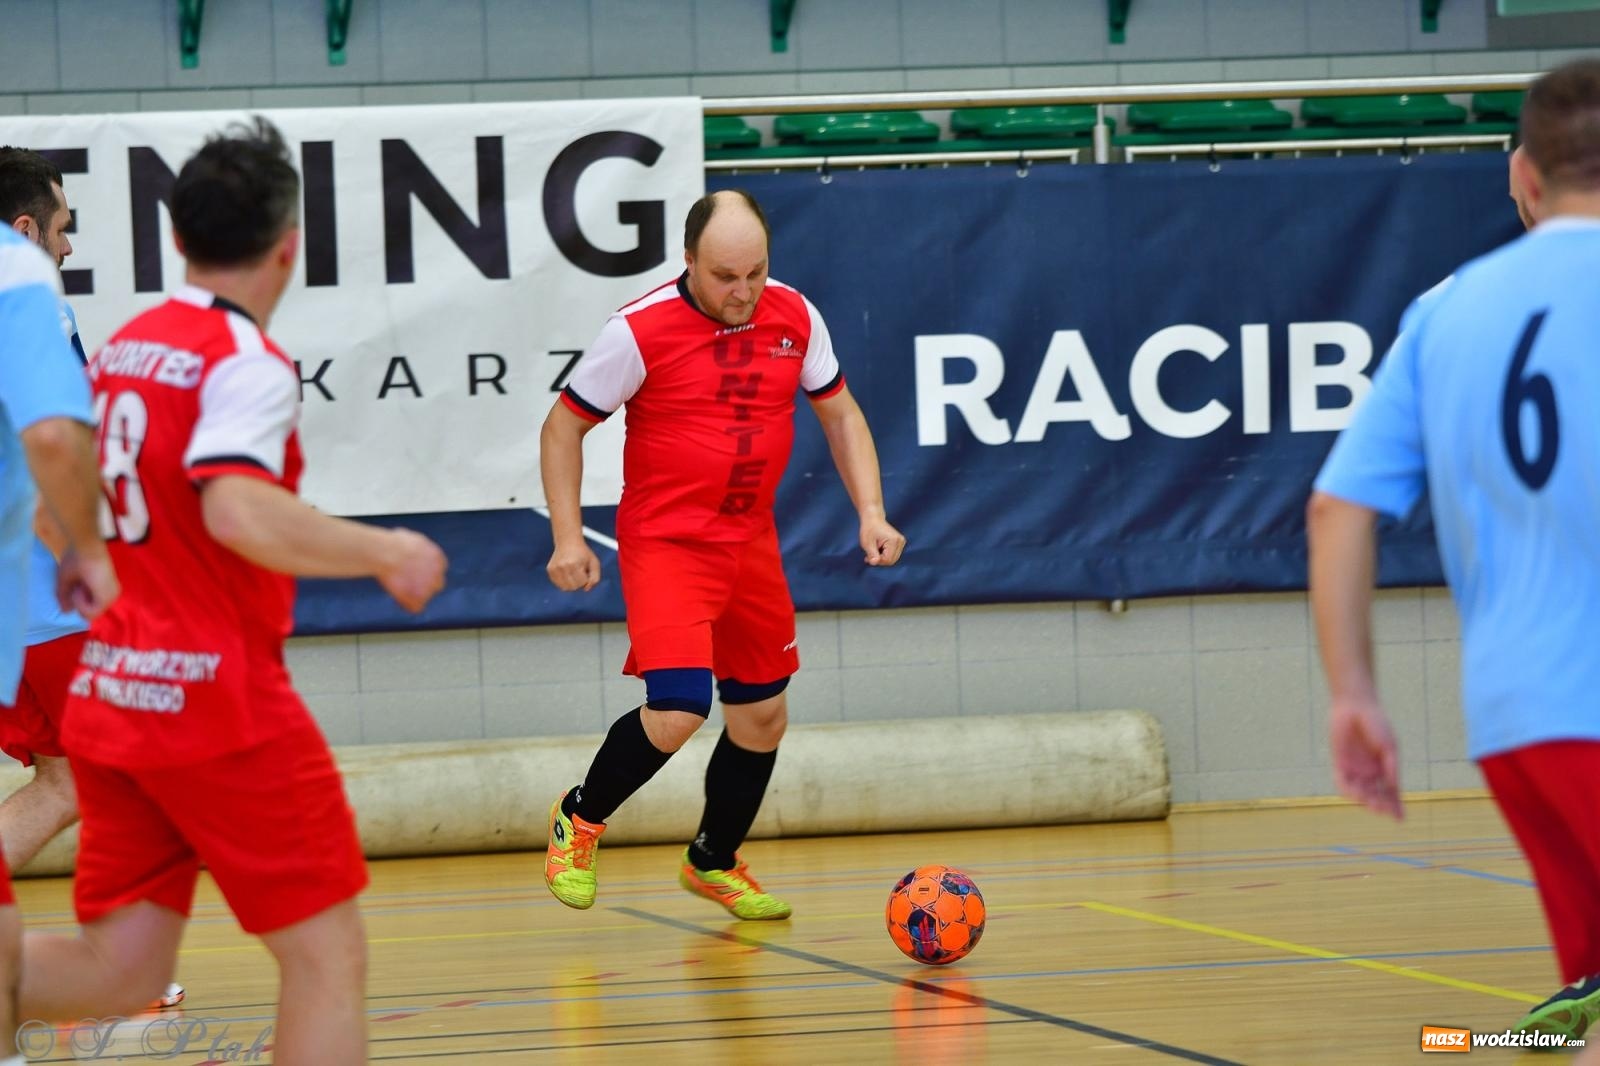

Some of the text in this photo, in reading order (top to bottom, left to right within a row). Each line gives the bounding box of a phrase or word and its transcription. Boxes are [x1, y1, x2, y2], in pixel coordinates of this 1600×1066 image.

[714, 338, 767, 516] UNITED
[914, 321, 1374, 447] RACIB
[1501, 308, 1559, 492] 6
